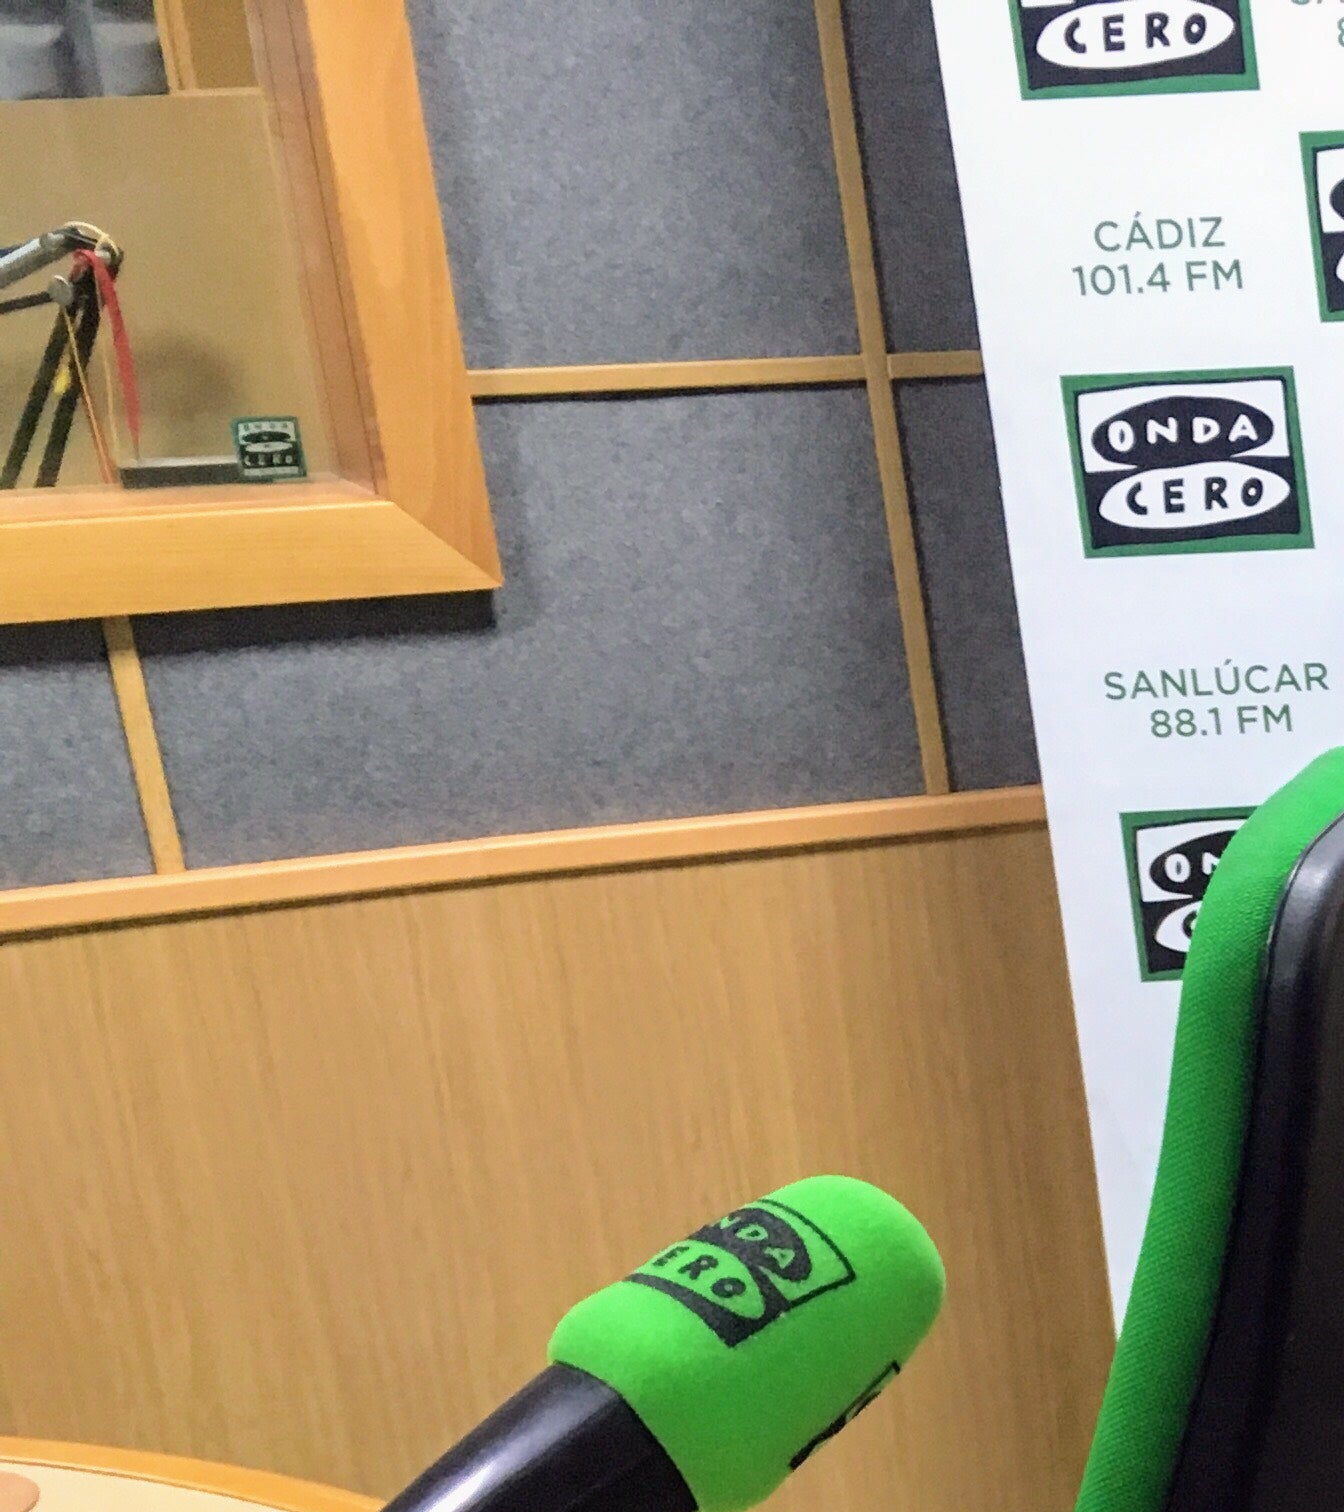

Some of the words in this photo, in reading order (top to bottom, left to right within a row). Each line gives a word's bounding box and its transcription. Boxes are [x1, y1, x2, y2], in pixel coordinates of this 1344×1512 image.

[1064, 12, 1208, 54] CERO
[1094, 211, 1227, 253] CÁDIZ
[1071, 261, 1172, 297] 101.4
[1186, 257, 1244, 292] FM
[1107, 413, 1259, 452] ONDA
[1125, 475, 1264, 516] CERO
[1103, 658, 1330, 701] SANLÚCAR
[1150, 710, 1224, 739] 88.1
[1237, 705, 1293, 734] FM
[652, 1245, 747, 1299] ERO
